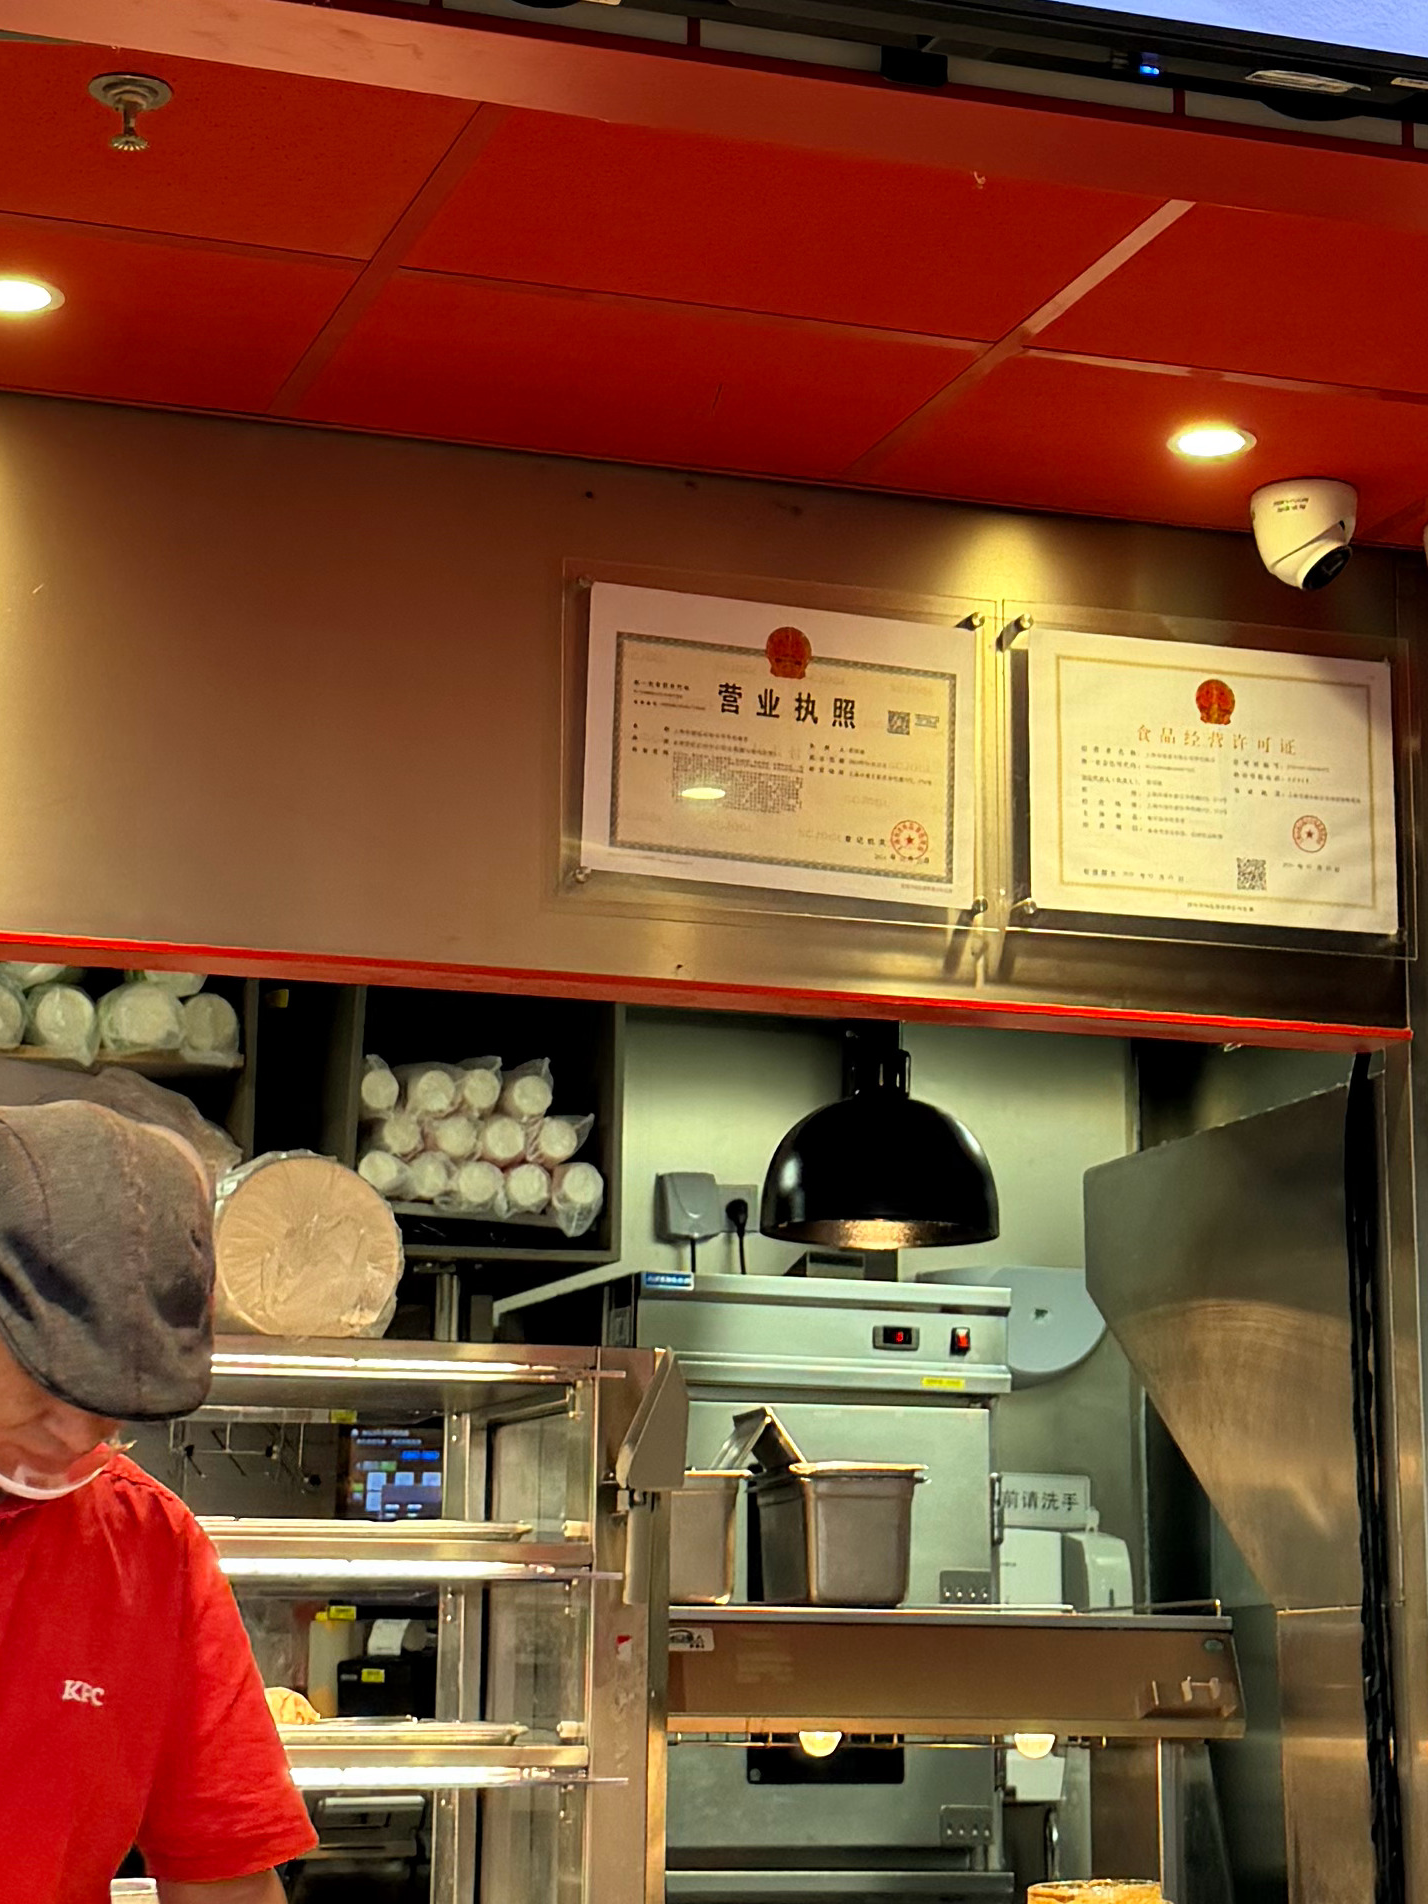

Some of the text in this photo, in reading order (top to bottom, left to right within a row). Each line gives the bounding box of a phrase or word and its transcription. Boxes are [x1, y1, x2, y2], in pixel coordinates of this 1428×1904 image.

[718, 682, 857, 729] 营业执照
[1138, 724, 1297, 756] 食品经营许可证
[62, 1678, 105, 1707] KFC
